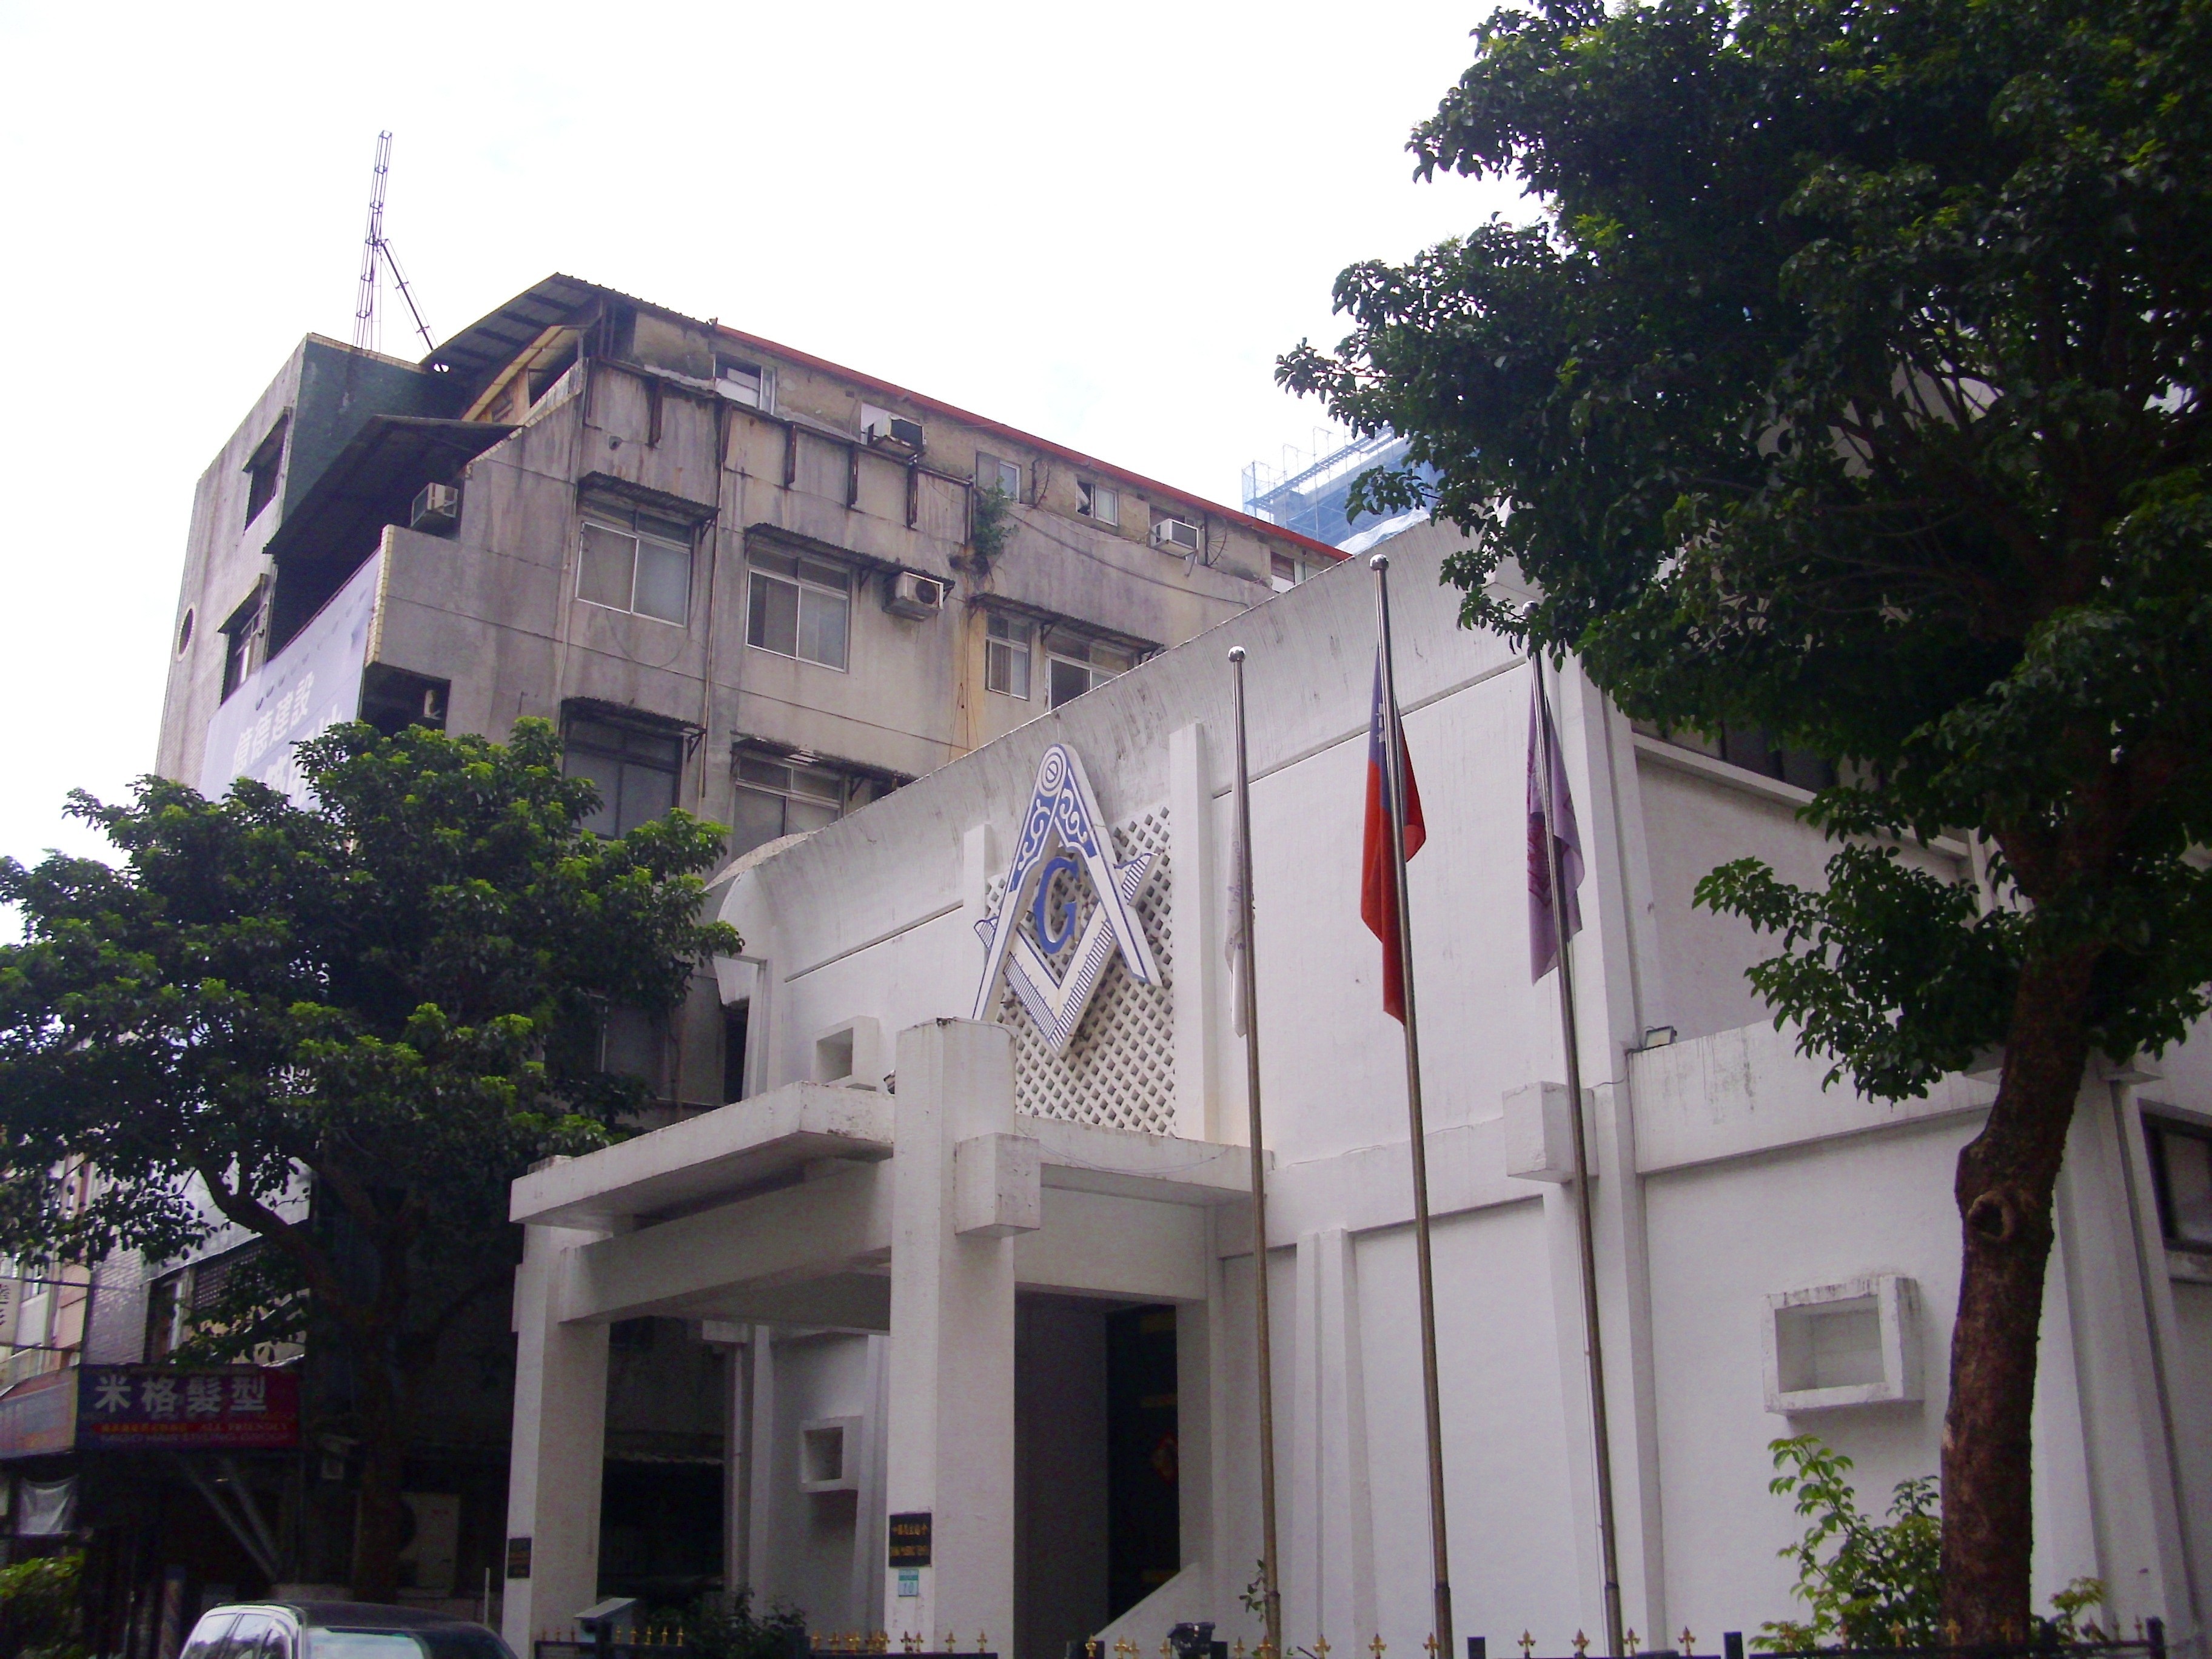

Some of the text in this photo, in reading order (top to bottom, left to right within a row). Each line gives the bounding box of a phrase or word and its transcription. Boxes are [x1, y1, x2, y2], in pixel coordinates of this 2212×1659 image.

[1034, 857, 1079, 954] G
[94, 1374, 266, 1413] 米格髮型
